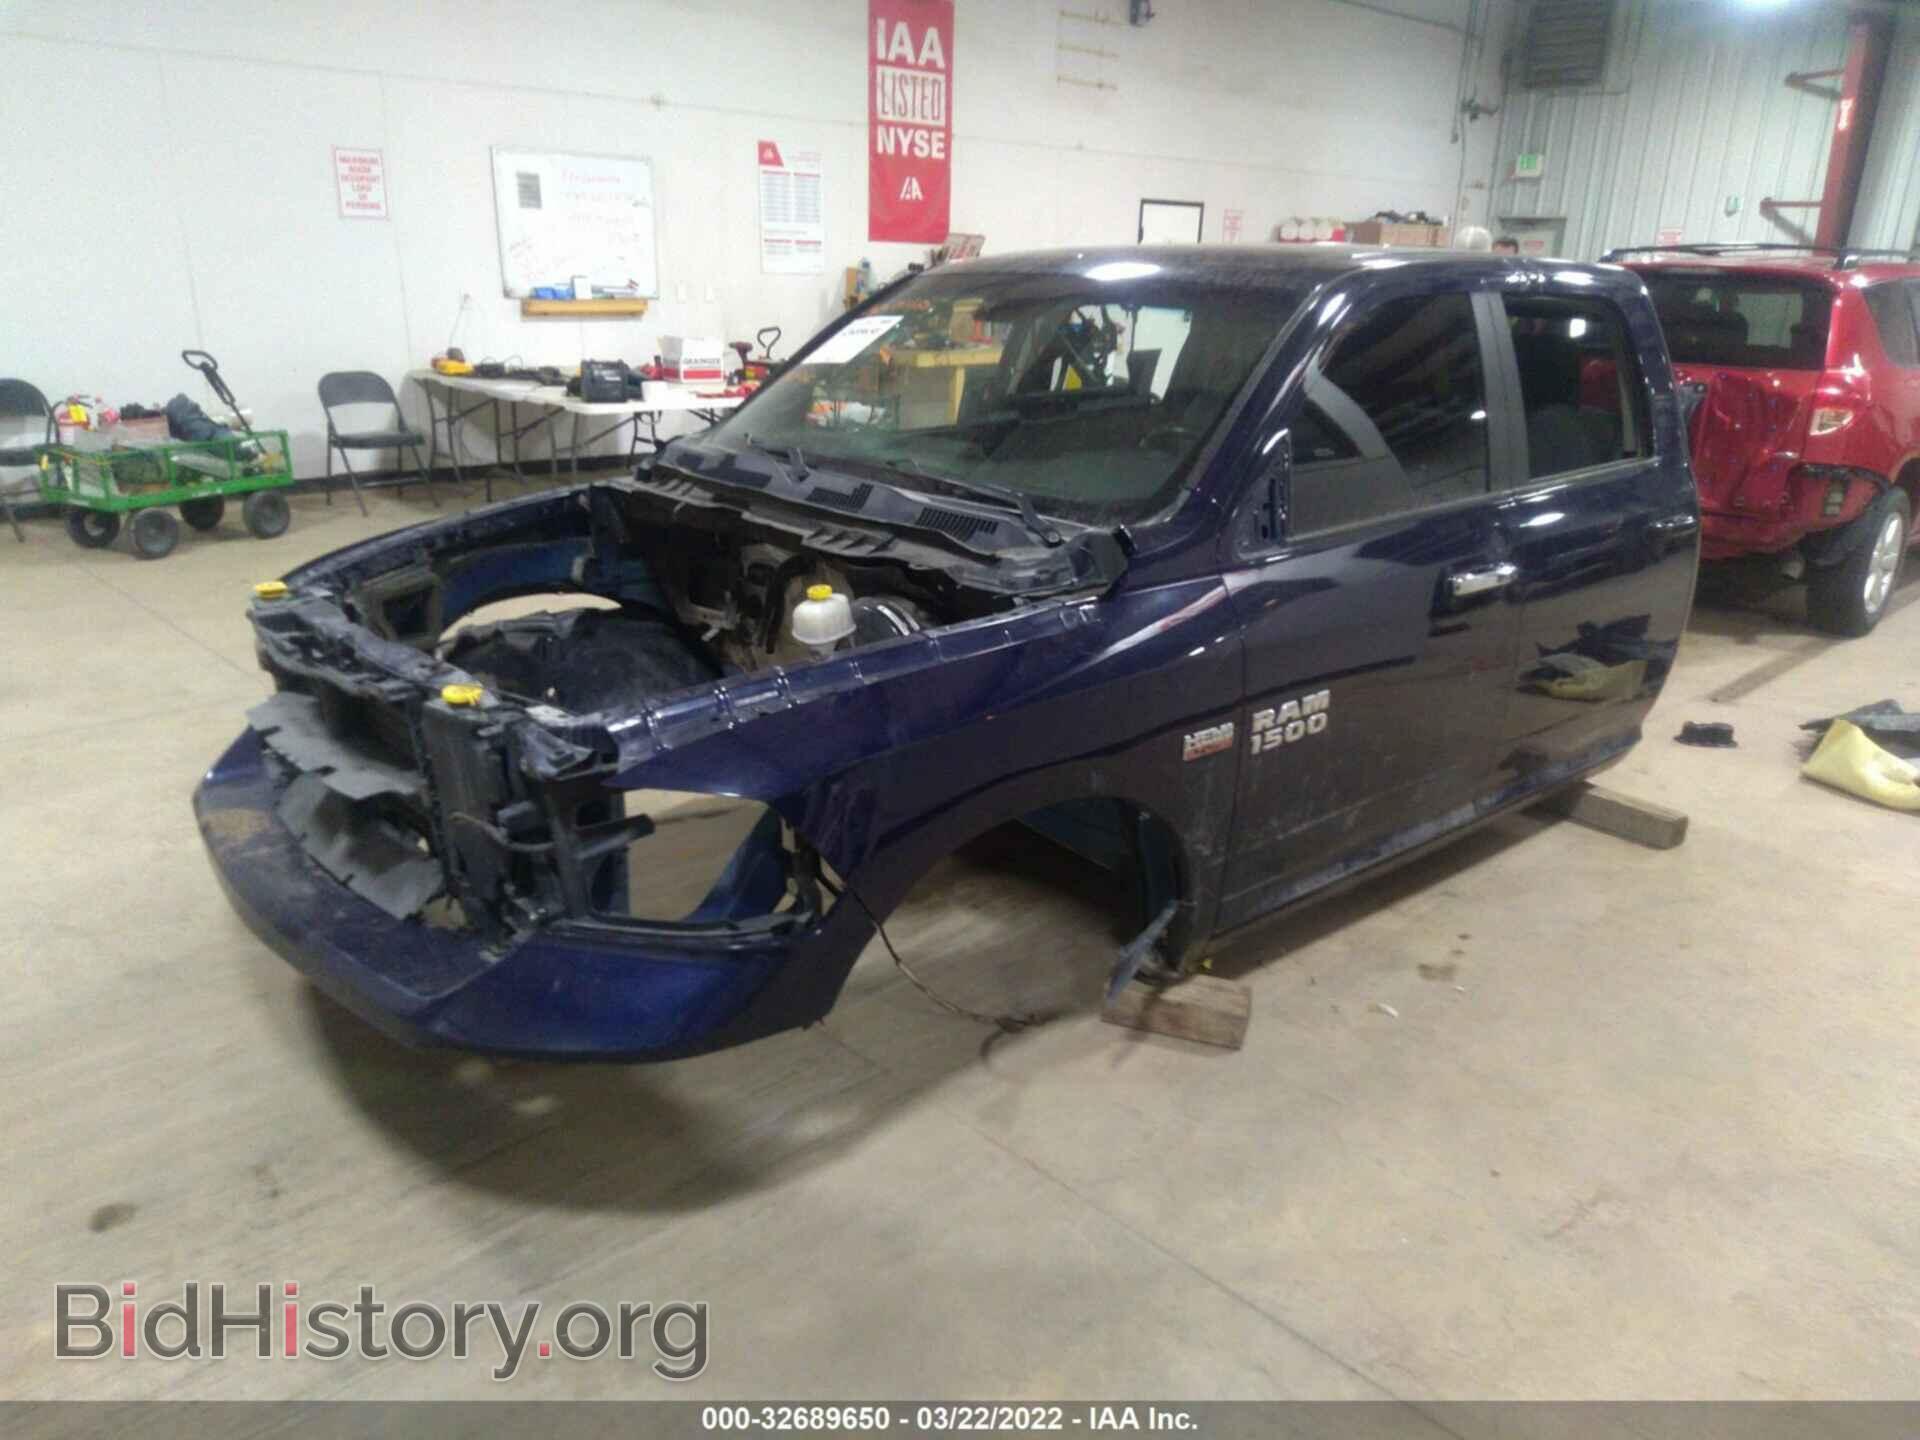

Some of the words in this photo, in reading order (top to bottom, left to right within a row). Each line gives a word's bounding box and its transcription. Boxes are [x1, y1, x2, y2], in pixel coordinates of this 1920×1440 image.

[876, 18, 946, 68] IAA
[881, 72, 942, 121] LISTED
[876, 126, 945, 159] NYSE
[1252, 689, 1331, 733] RAM
[1250, 712, 1328, 755] 1500
